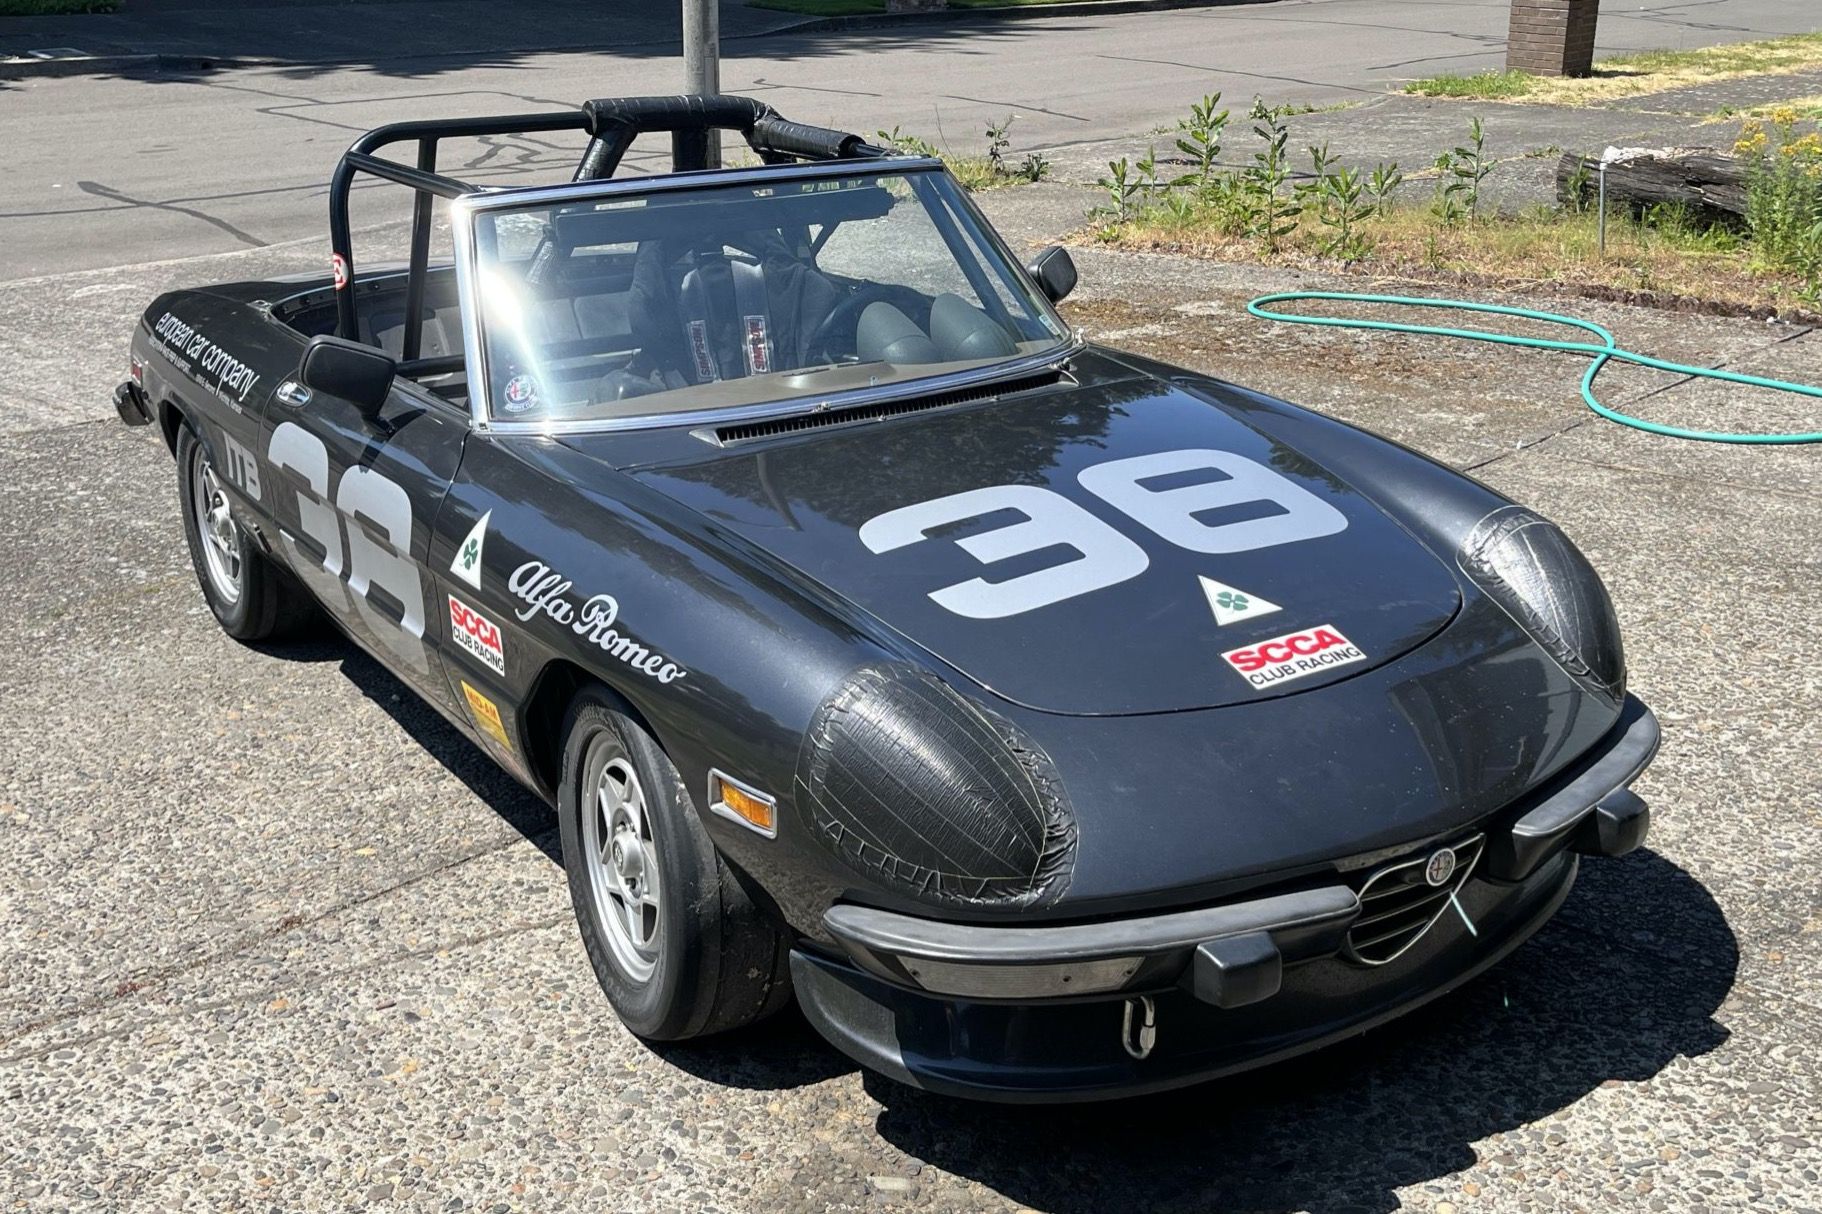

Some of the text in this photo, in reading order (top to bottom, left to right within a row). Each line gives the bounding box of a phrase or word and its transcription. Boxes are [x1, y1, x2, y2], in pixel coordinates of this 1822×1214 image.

[155, 312, 194, 351] european
[186, 333, 211, 360] car
[201, 345, 260, 402] company
[222, 429, 261, 501] ITB
[267, 421, 430, 676] 38
[859, 448, 1349, 619] 38
[450, 599, 502, 653] SCCA
[453, 626, 503, 671] CLUB RACING
[508, 561, 687, 683] Alfa Romeo
[1229, 629, 1347, 672] SCCA
[1249, 646, 1362, 685] CLUB RACING
